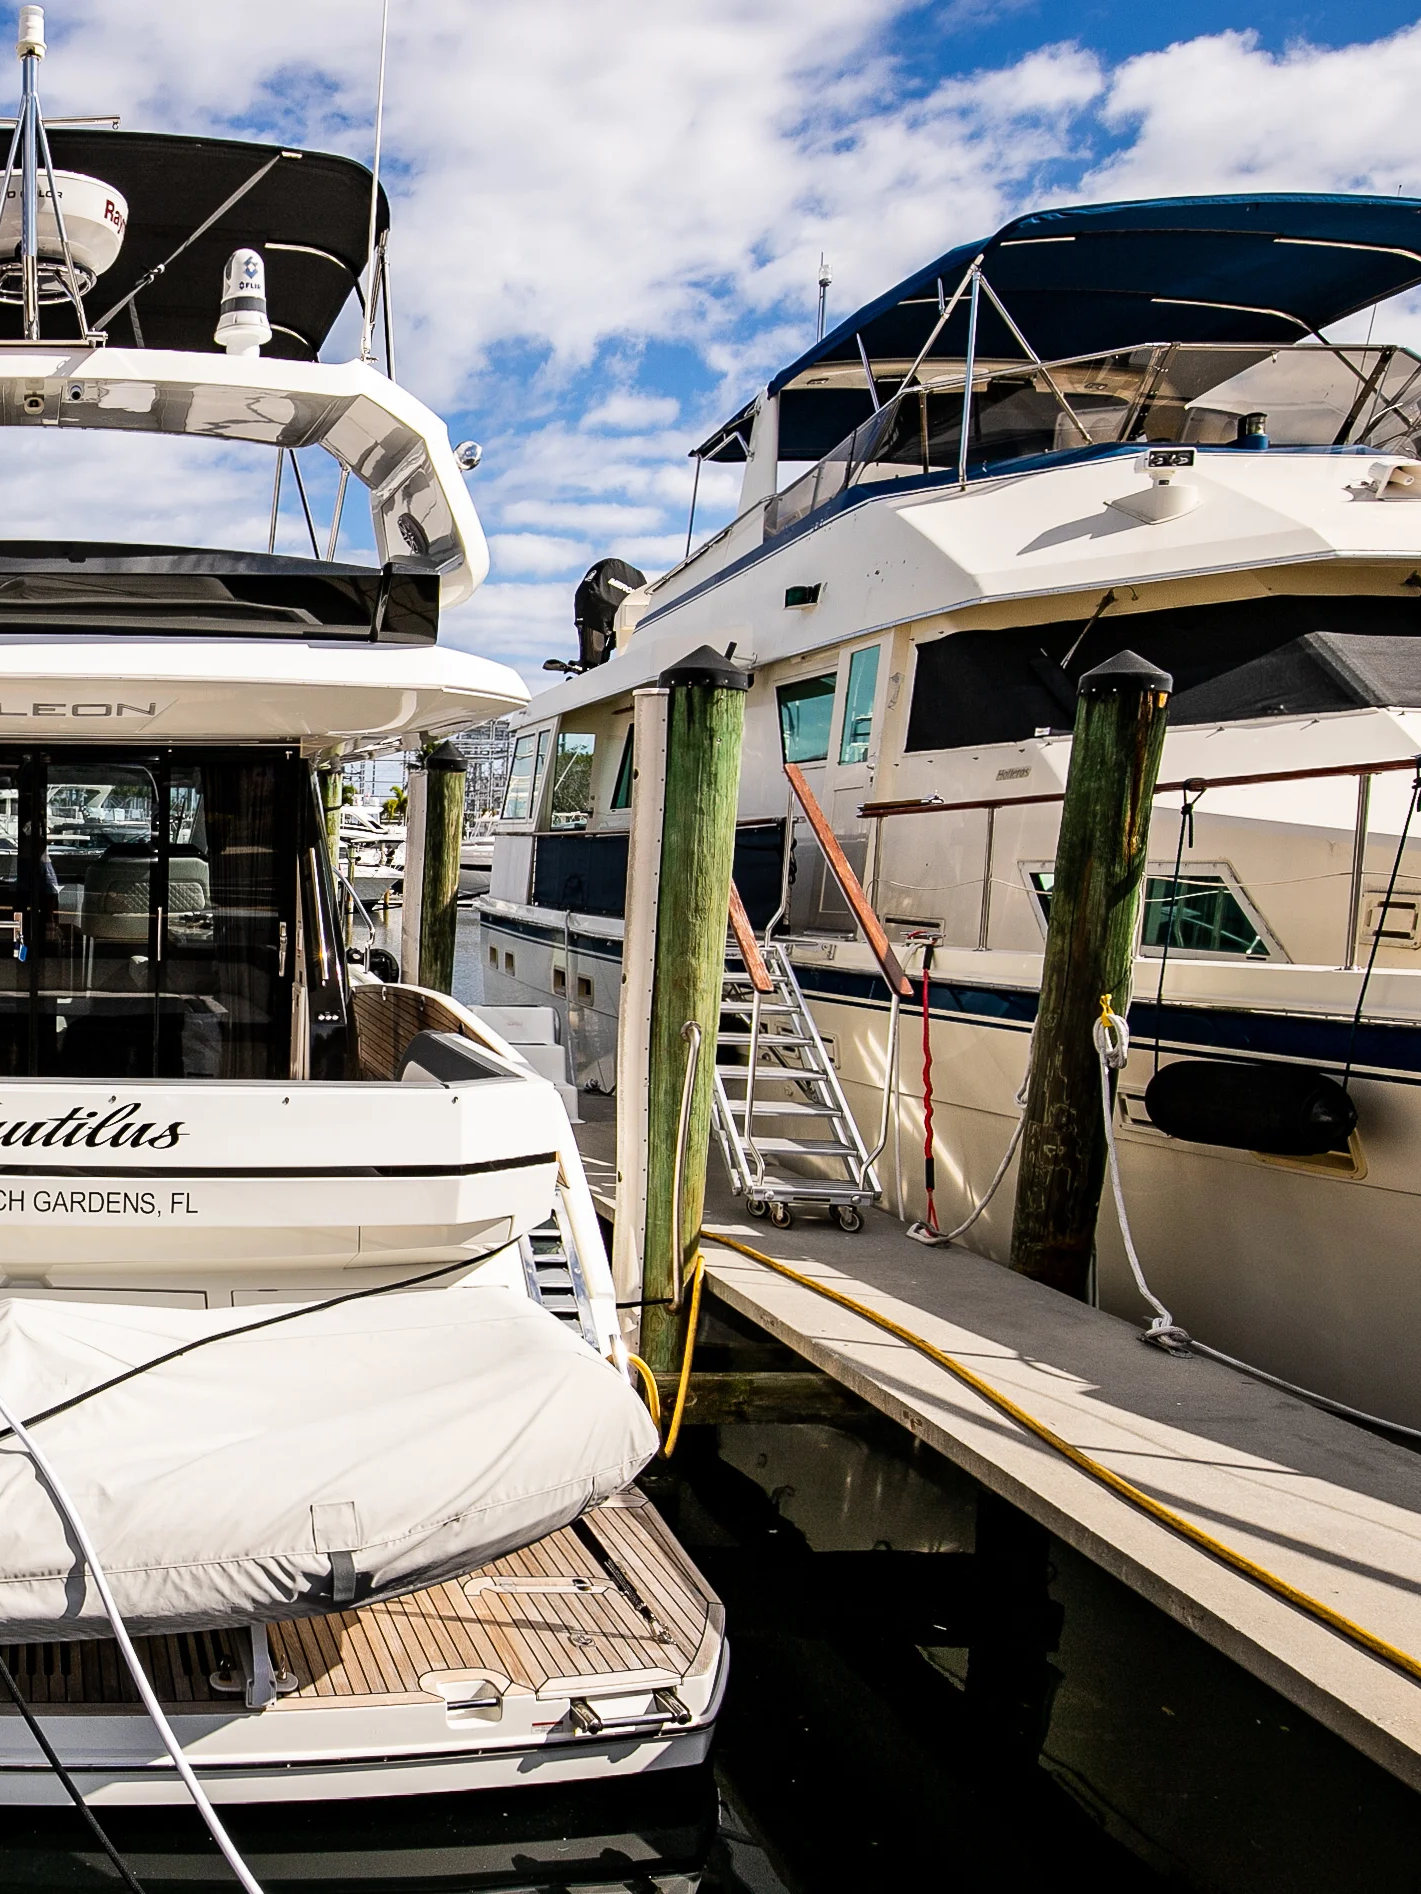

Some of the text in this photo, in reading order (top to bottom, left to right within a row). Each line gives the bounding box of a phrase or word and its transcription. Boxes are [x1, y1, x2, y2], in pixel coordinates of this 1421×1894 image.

[0, 190, 16, 198] D
[104, 199, 127, 234] Ray
[33, 1190, 161, 1217] GARDENS,
[171, 1192, 198, 1214] FL
